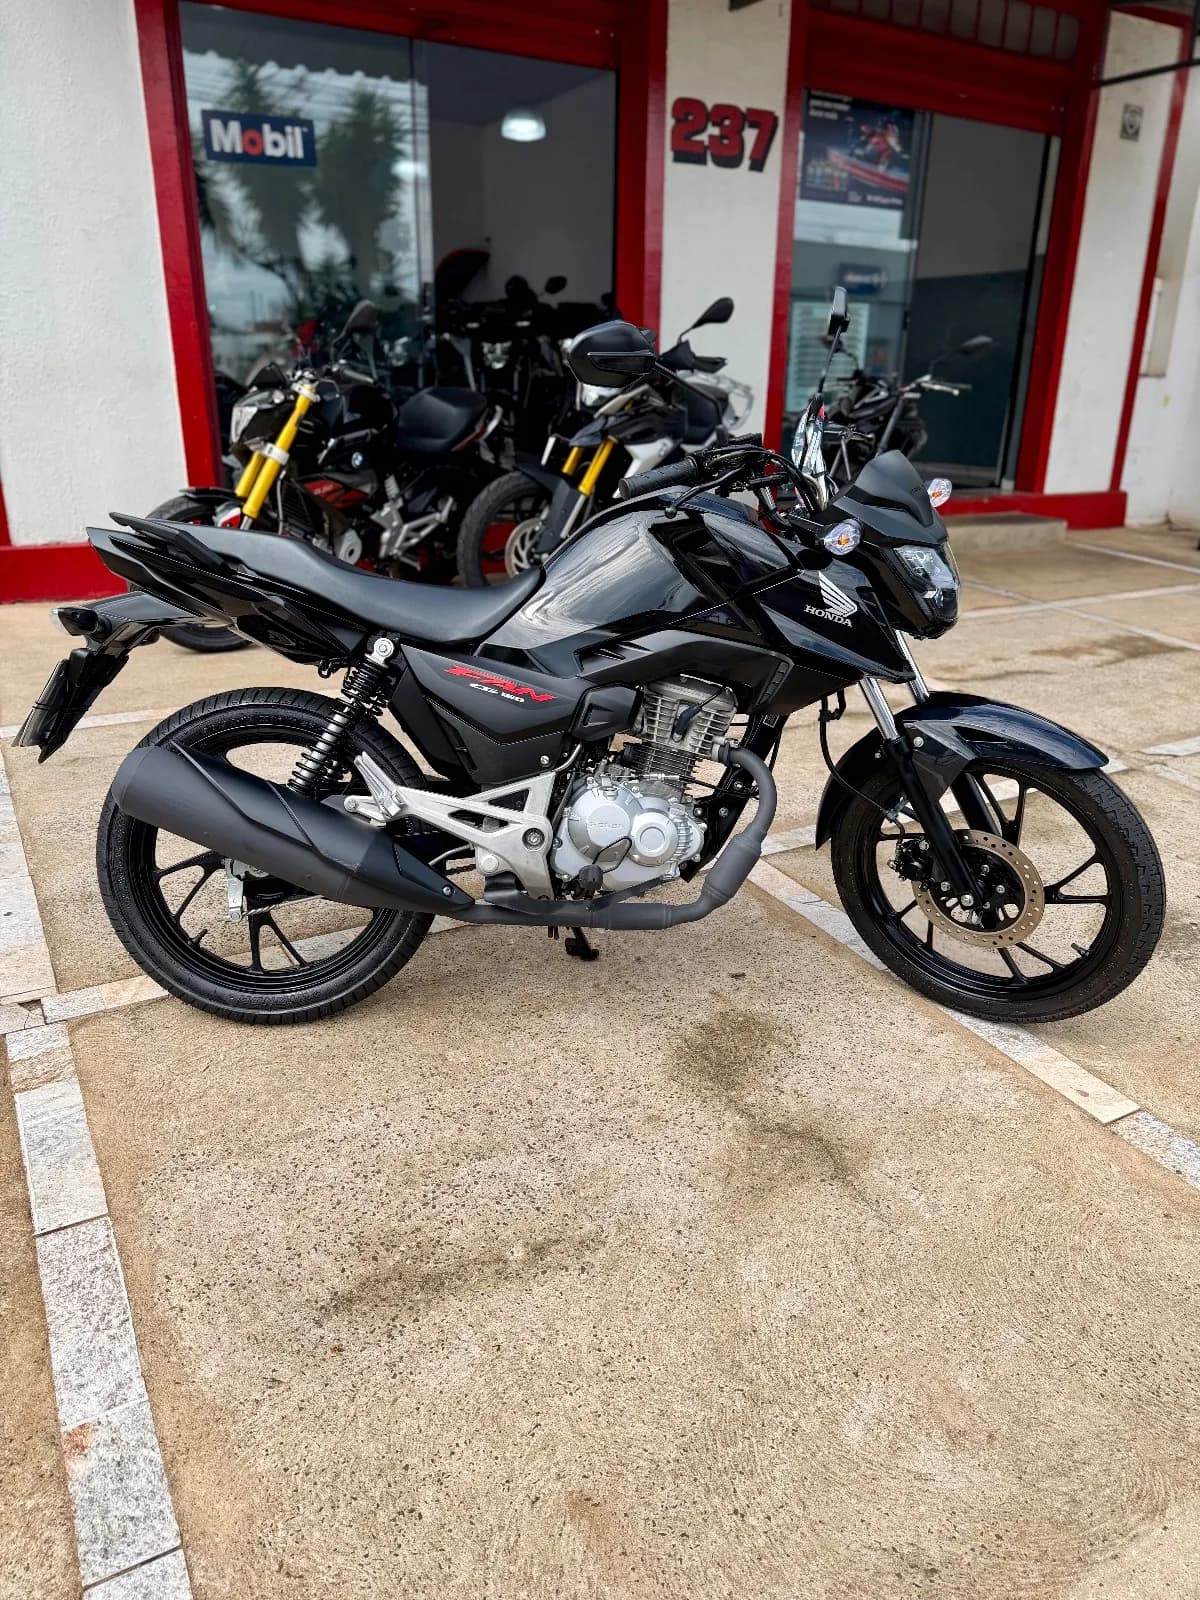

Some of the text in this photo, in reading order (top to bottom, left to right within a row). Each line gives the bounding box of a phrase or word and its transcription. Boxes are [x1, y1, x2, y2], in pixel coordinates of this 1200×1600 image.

[209, 118, 305, 159] Mobil
[671, 96, 779, 173] 237
[803, 603, 853, 628] HONDA
